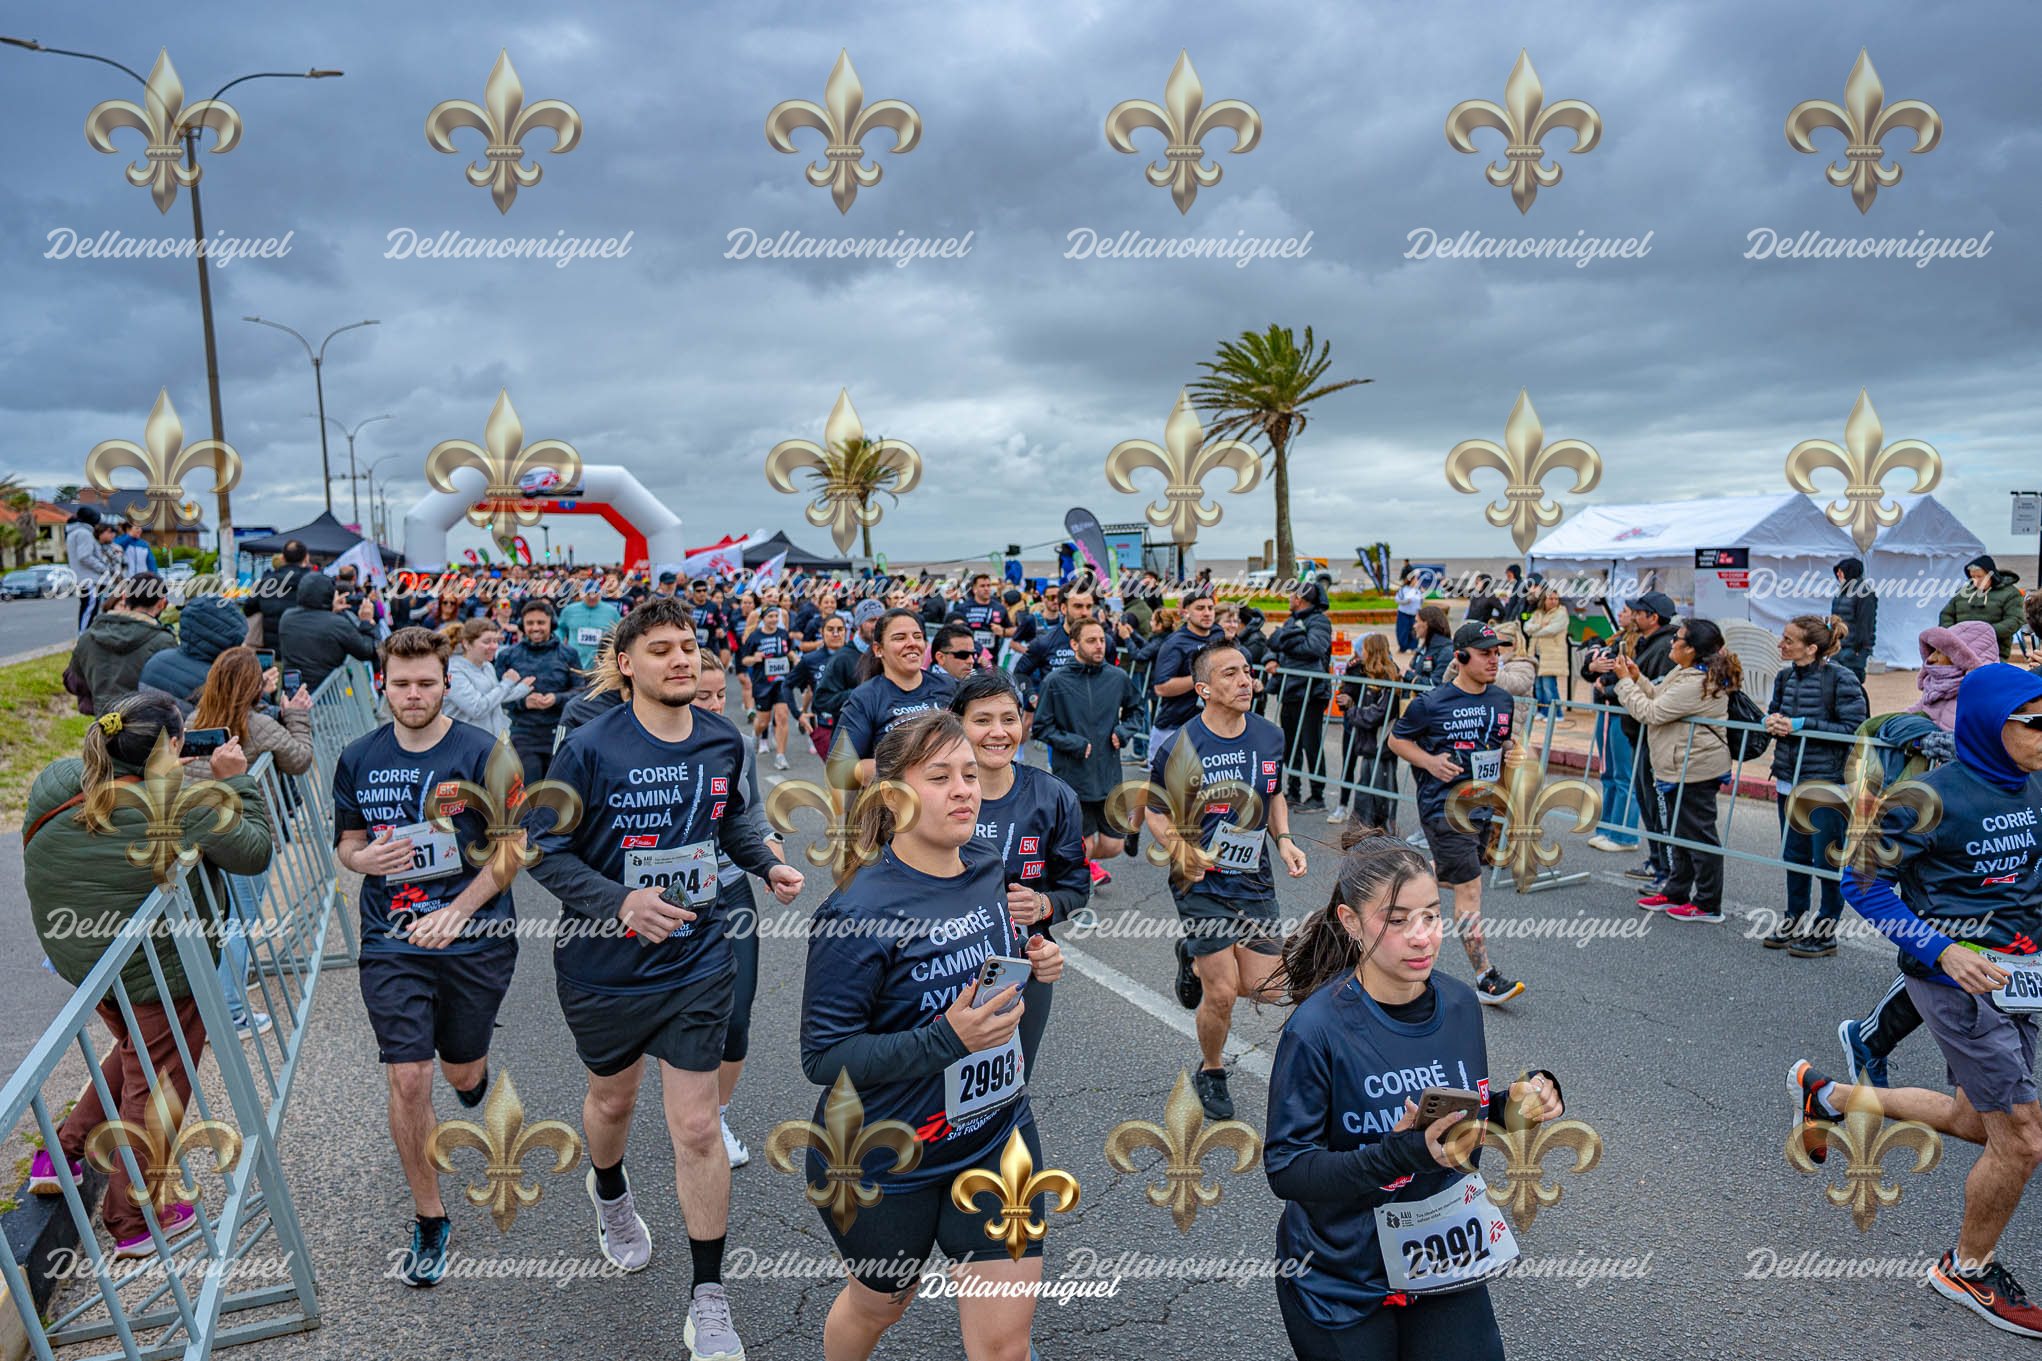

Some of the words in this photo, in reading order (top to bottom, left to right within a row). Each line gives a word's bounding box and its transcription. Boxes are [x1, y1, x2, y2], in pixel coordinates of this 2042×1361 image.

[1453, 705, 1487, 718] CORRÉ
[1443, 717, 1485, 731] CAMINÁ
[1447, 728, 1480, 740] AYUDÁ
[1202, 750, 1247, 769] CORRÉ
[369, 768, 420, 783] CORRÉ
[629, 762, 688, 785] CORRÉ
[1189, 766, 1244, 787] CAMINÁ
[1478, 762, 1499, 779] 2597
[356, 785, 413, 803] CAMINÁ
[608, 785, 683, 808] CAMINÁ
[1196, 783, 1239, 800] AYUDÁ
[611, 808, 673, 829] AYUDÁ
[1982, 807, 2037, 833] CORRÉ
[1023, 841, 1036, 851] 5K
[1218, 841, 1254, 863] 2119
[1966, 828, 2037, 856] CAMINÁ
[1973, 850, 2028, 874] AYUDÁ
[930, 905, 995, 946] CORRÉ
[911, 935, 996, 982] CAMINÁ
[960, 1049, 1015, 1104] 2993
[1364, 1059, 1449, 1098] CORRÉ
[1402, 1217, 1491, 1281] 2992
